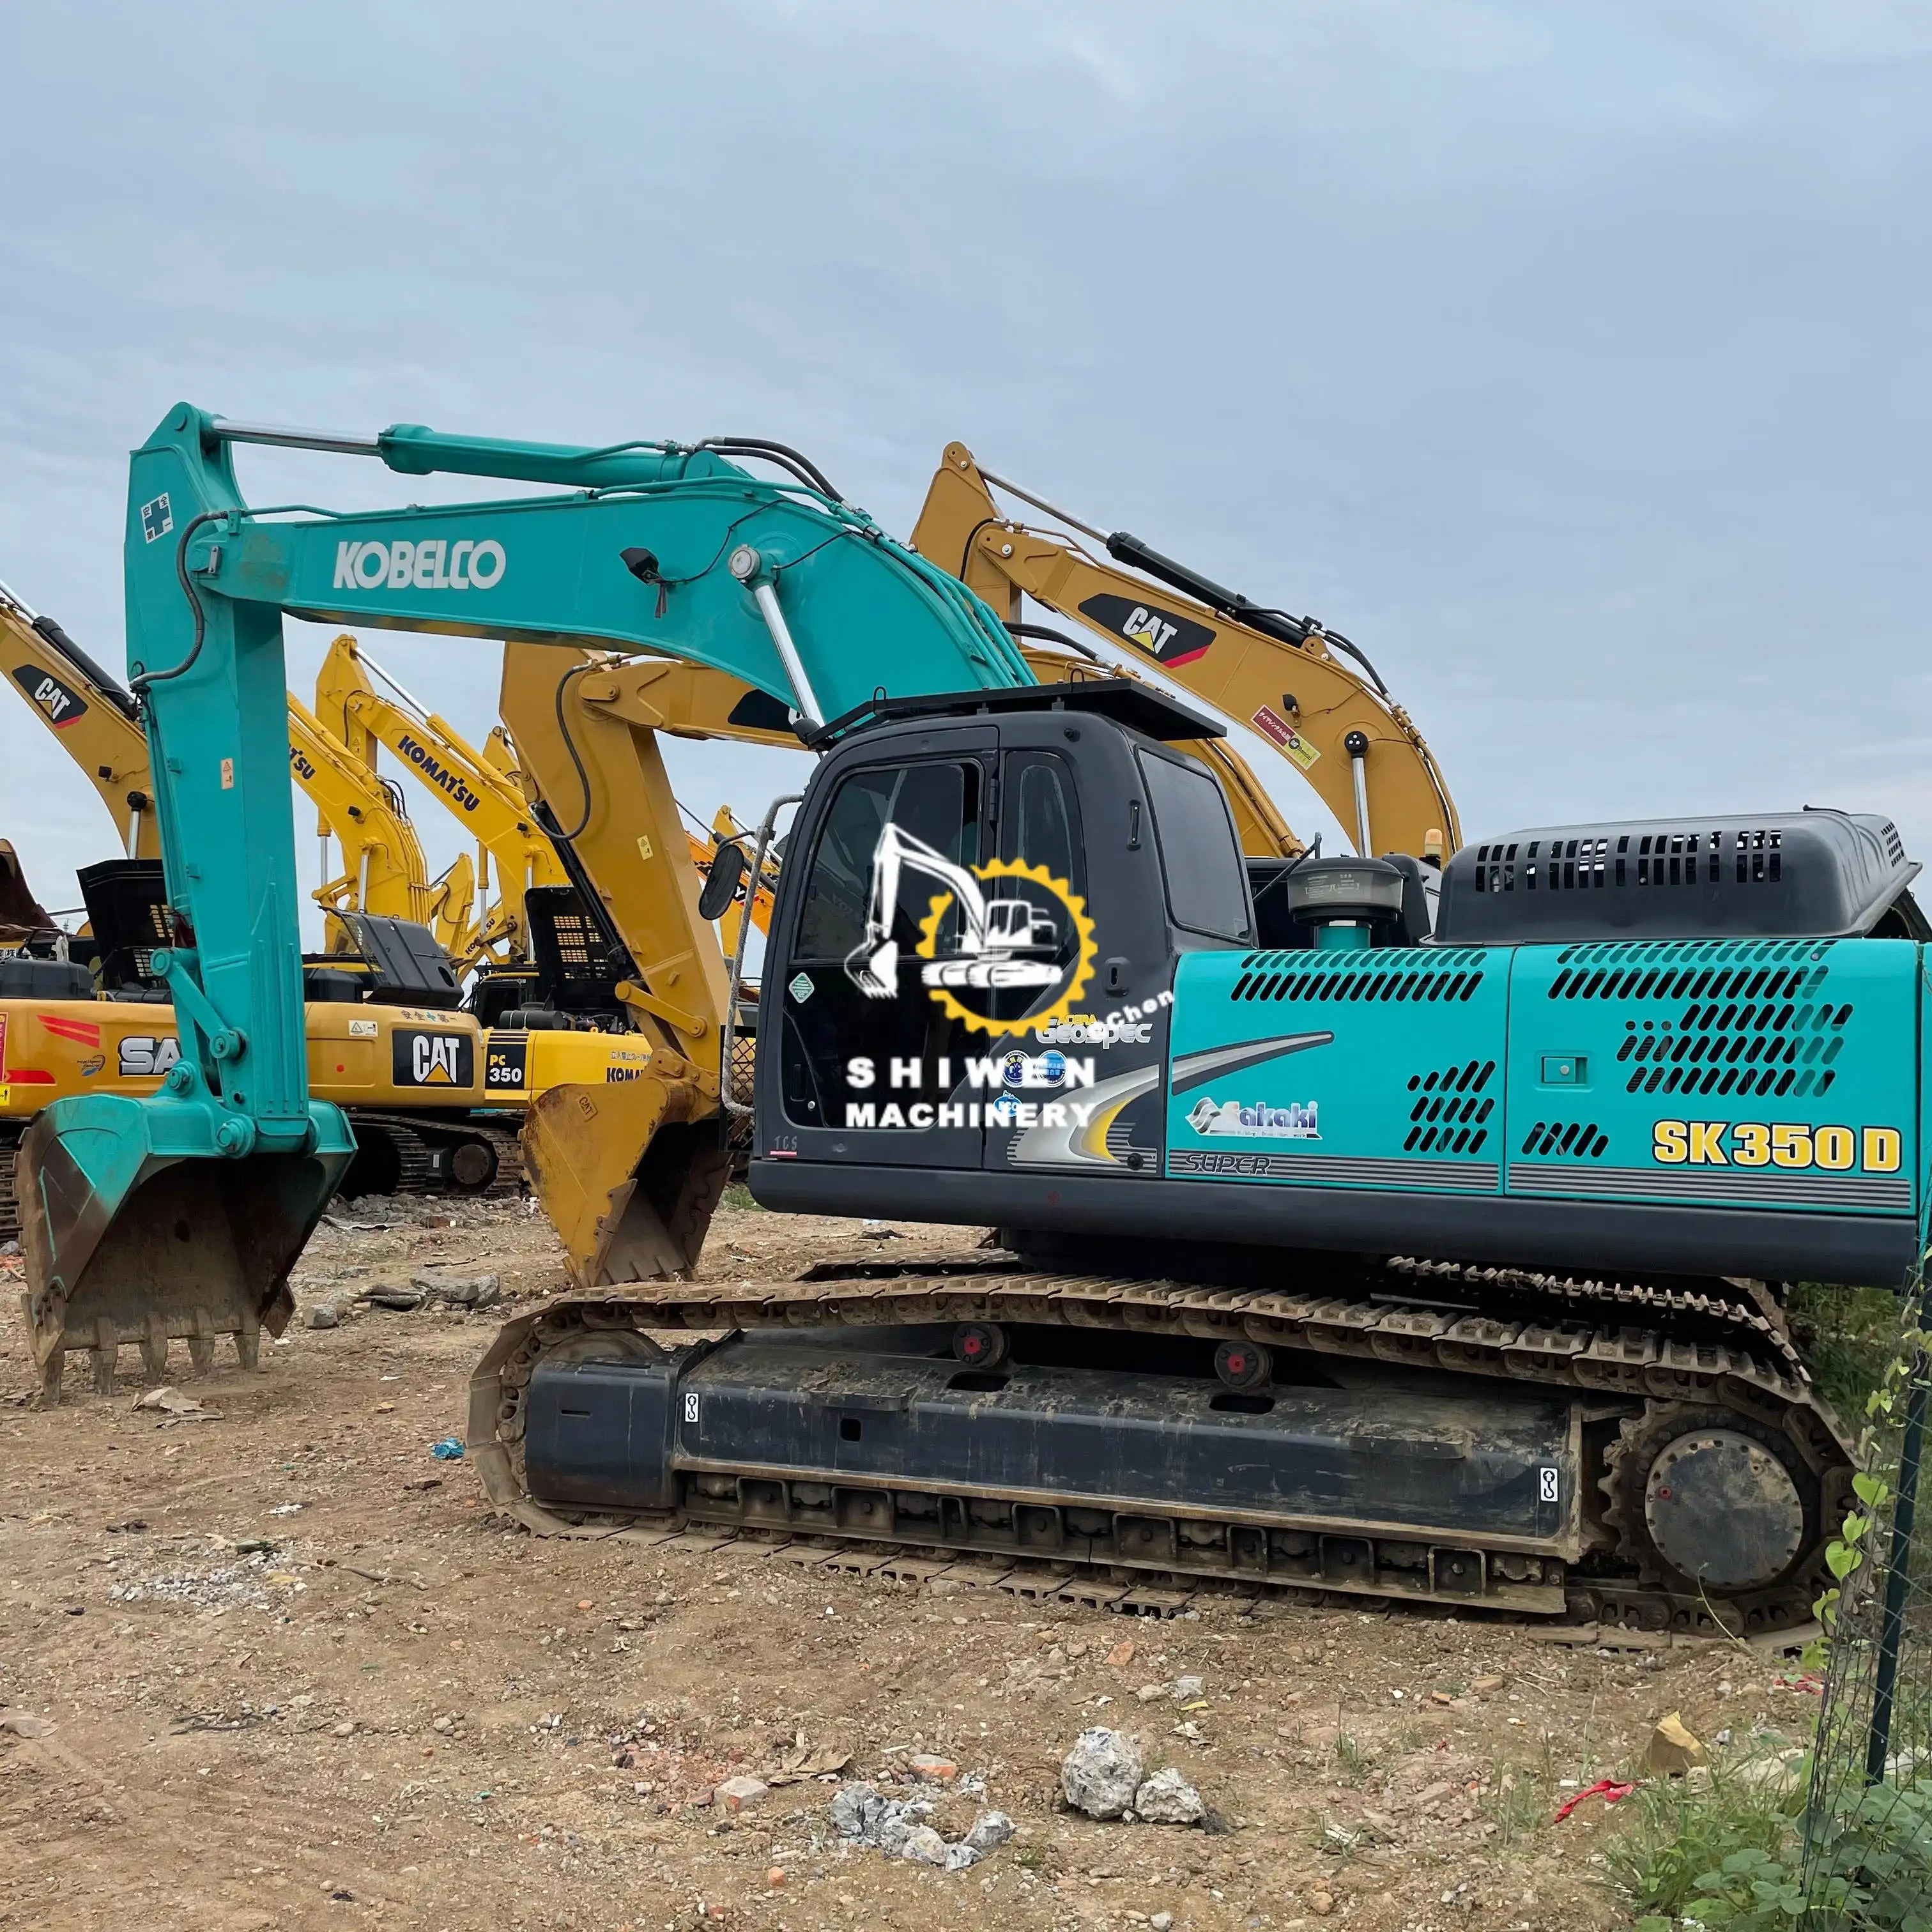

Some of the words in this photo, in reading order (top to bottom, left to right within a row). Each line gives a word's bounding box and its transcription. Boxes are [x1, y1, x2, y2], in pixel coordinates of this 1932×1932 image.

[333, 540, 507, 589] KOBELCO
[1123, 606, 1178, 654] CAT
[34, 677, 71, 719] CAT
[397, 734, 480, 811] KOMATSU
[413, 1035, 459, 1083] CAT
[489, 1054, 506, 1066] PC
[489, 1068, 522, 1082] 350
[606, 1068, 644, 1082] KOMA
[1184, 1153, 1271, 1176] SUPER
